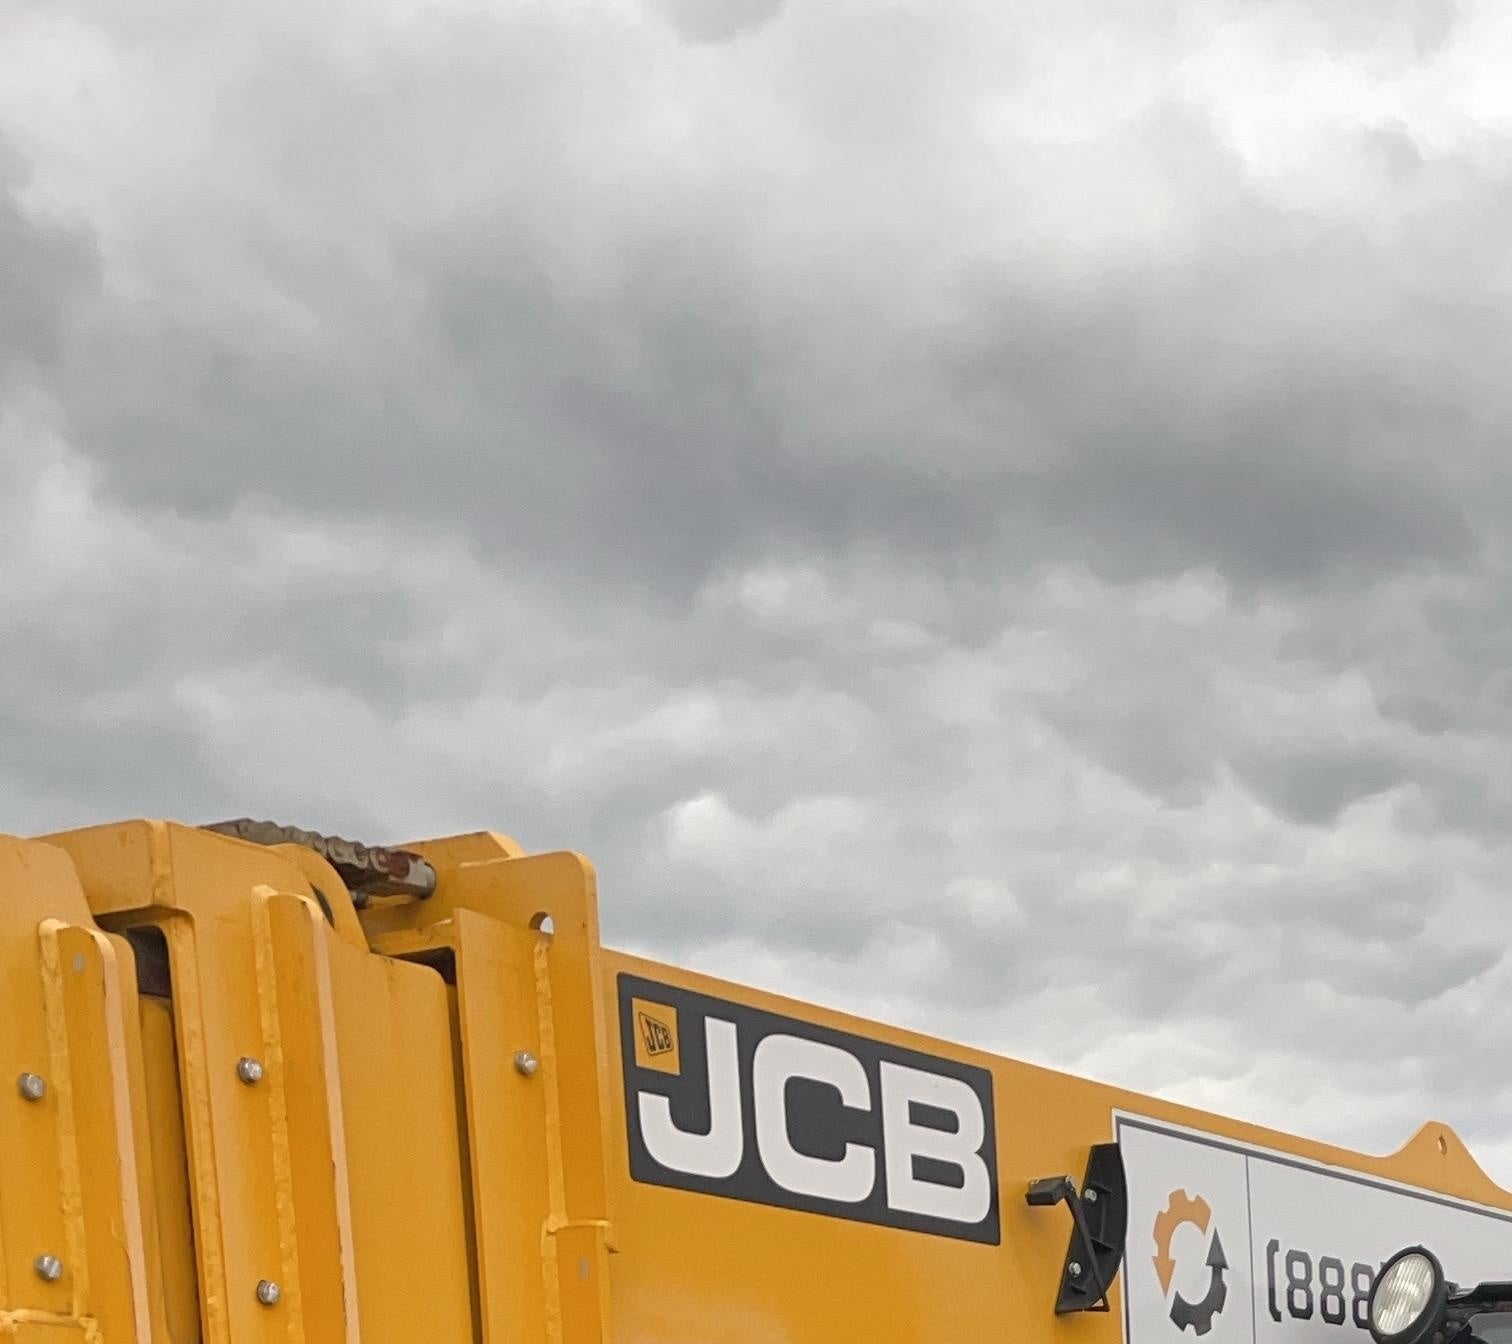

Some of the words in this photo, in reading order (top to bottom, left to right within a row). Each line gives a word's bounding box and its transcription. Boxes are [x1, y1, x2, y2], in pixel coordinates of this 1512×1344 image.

[645, 1018, 672, 1052] JCB
[637, 1015, 992, 1224] JCB
[1266, 1238, 1385, 1330] (888
